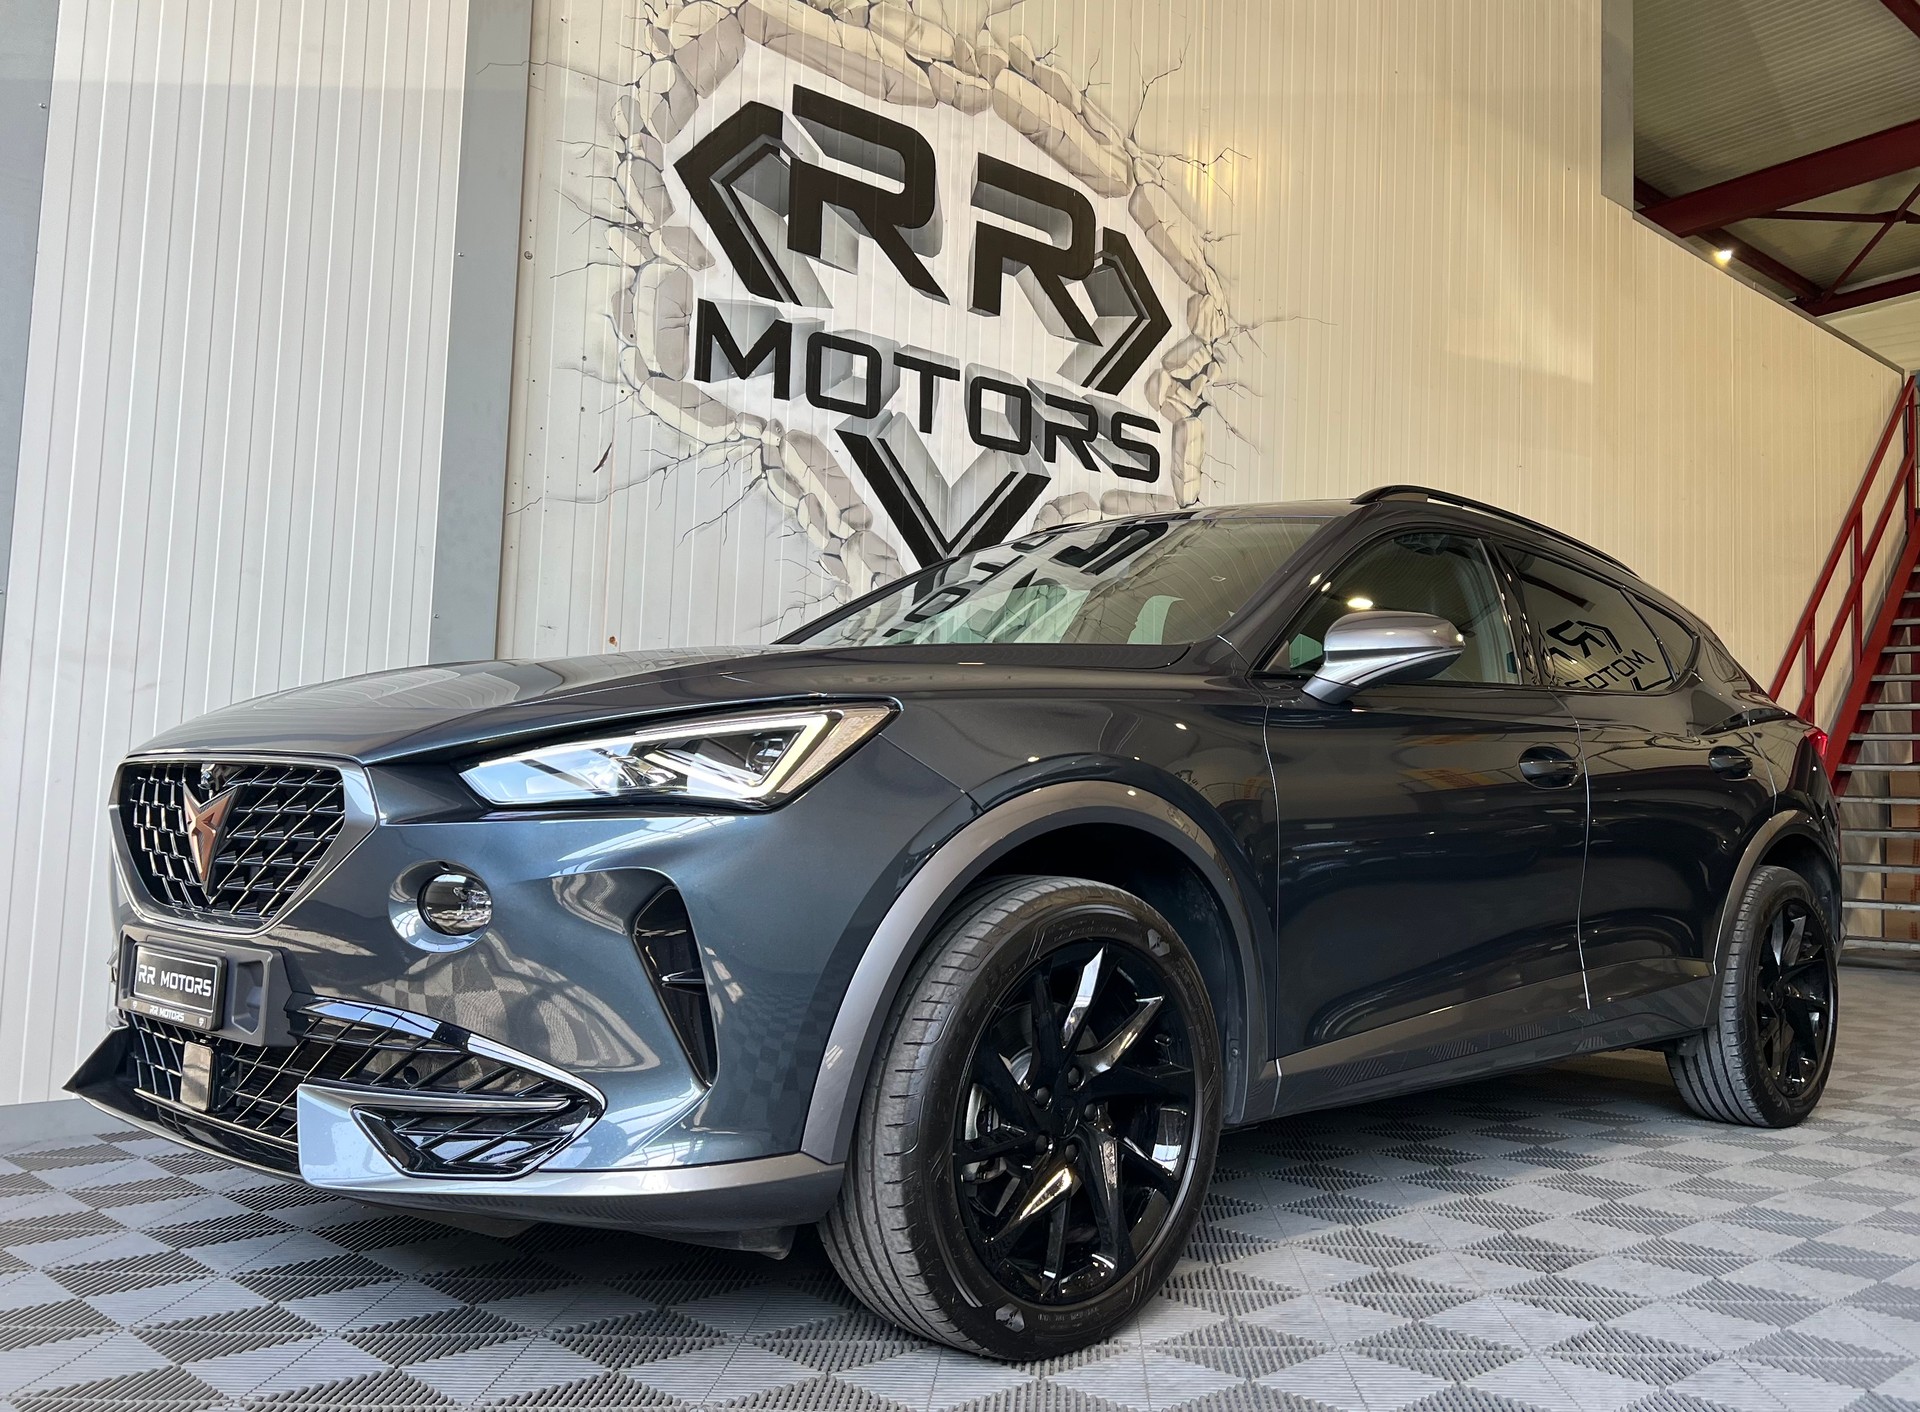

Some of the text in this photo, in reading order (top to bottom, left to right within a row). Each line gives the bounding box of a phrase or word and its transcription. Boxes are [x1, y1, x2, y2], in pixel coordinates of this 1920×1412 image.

[787, 85, 1103, 347] RR
[693, 298, 1161, 483] MOTORS
[139, 965, 212, 996] RR MOTORS
[149, 1005, 184, 1021] RR MOTORS
